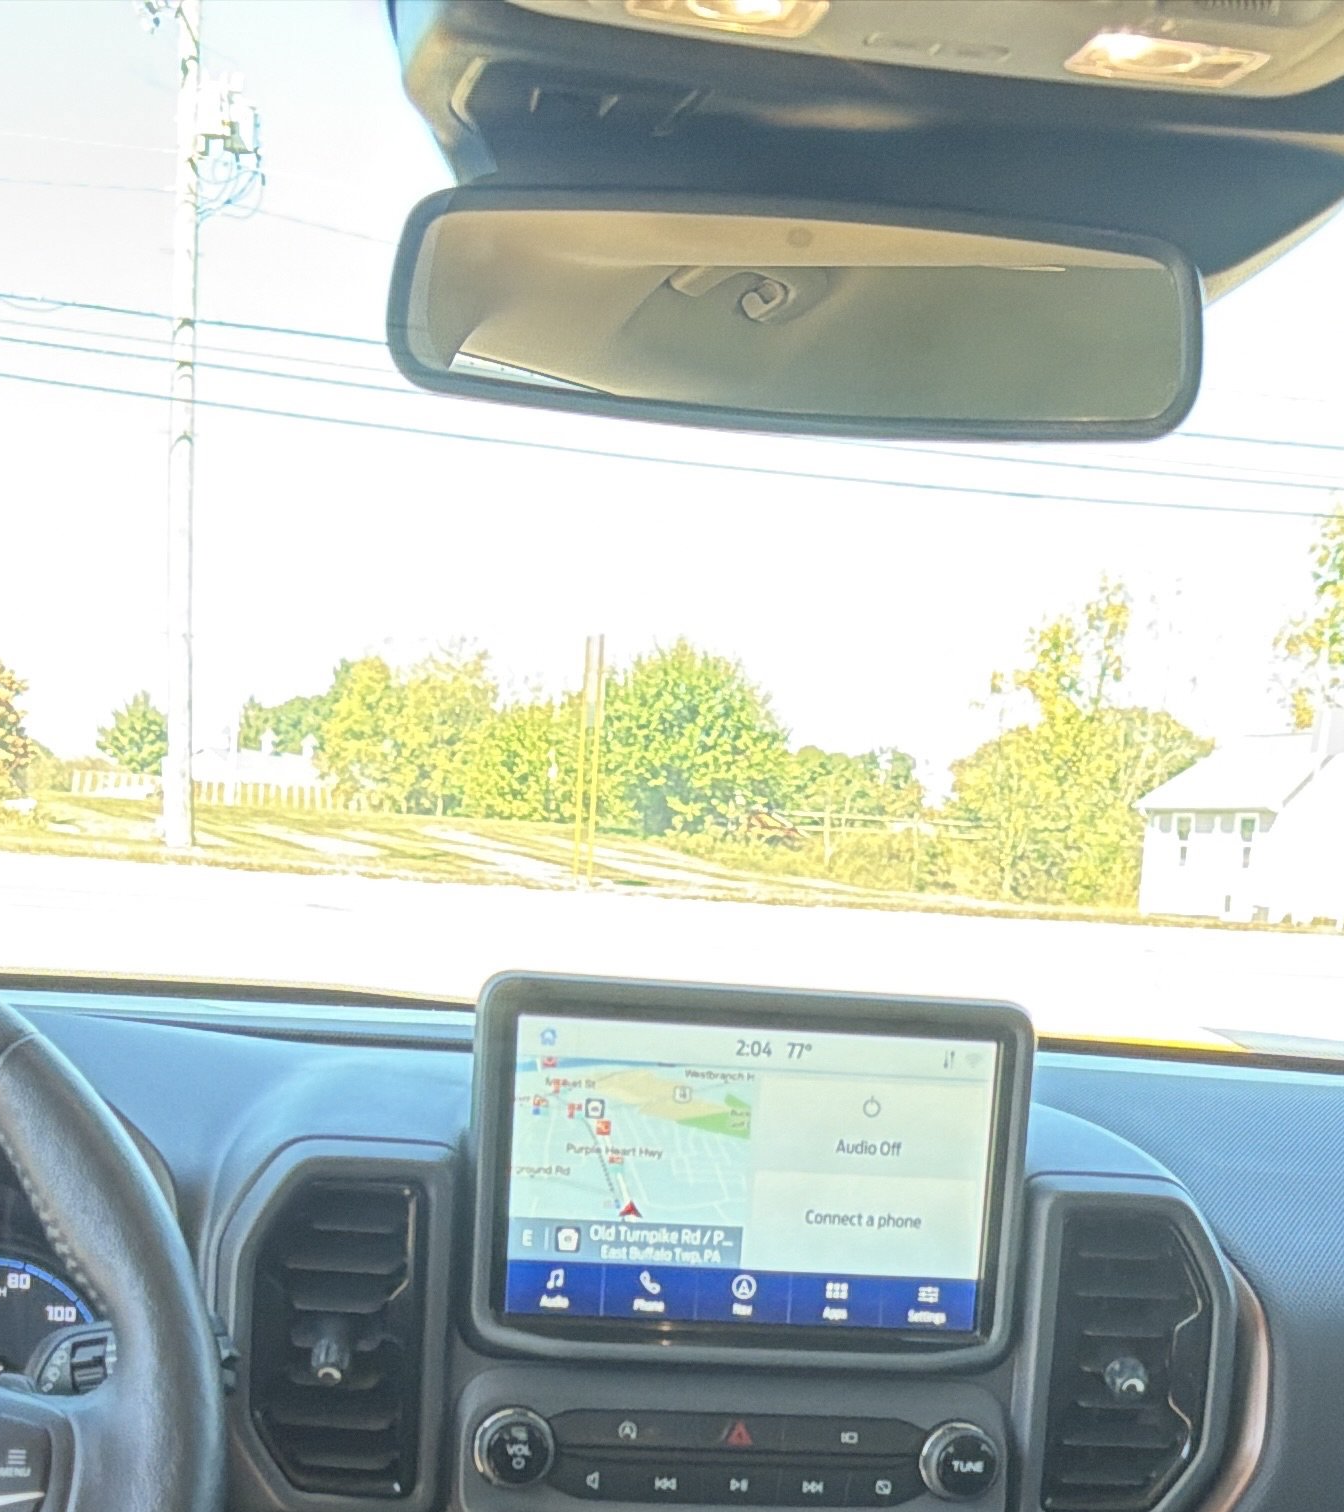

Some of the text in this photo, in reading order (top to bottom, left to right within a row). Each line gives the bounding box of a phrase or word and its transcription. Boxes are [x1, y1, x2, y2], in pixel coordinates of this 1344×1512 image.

[735, 1039, 773, 1058] 2:04
[566, 1142, 664, 1160] Purple Heart Hwy
[835, 1138, 903, 1157] Audio Off
[555, 1165, 571, 1177] Rd
[805, 1208, 923, 1230] Connect a phone
[522, 1229, 533, 1247] E
[589, 1224, 616, 1242] Old
[618, 1226, 680, 1247] Turnpike
[682, 1228, 702, 1245] Rd
[600, 1245, 628, 1261] East
[629, 1247, 673, 1263] Buffalo
[703, 1250, 722, 1264] PA
[6, 1273, 31, 1290] 80
[539, 1293, 570, 1309] Audio
[632, 1298, 666, 1313] Phone
[732, 1302, 754, 1317] Nav
[44, 1305, 77, 1322] 100
[822, 1306, 849, 1321] Apps
[907, 1309, 947, 1326] Settings
[505, 1443, 532, 1456] VOL
[951, 1460, 985, 1473] TUNE
